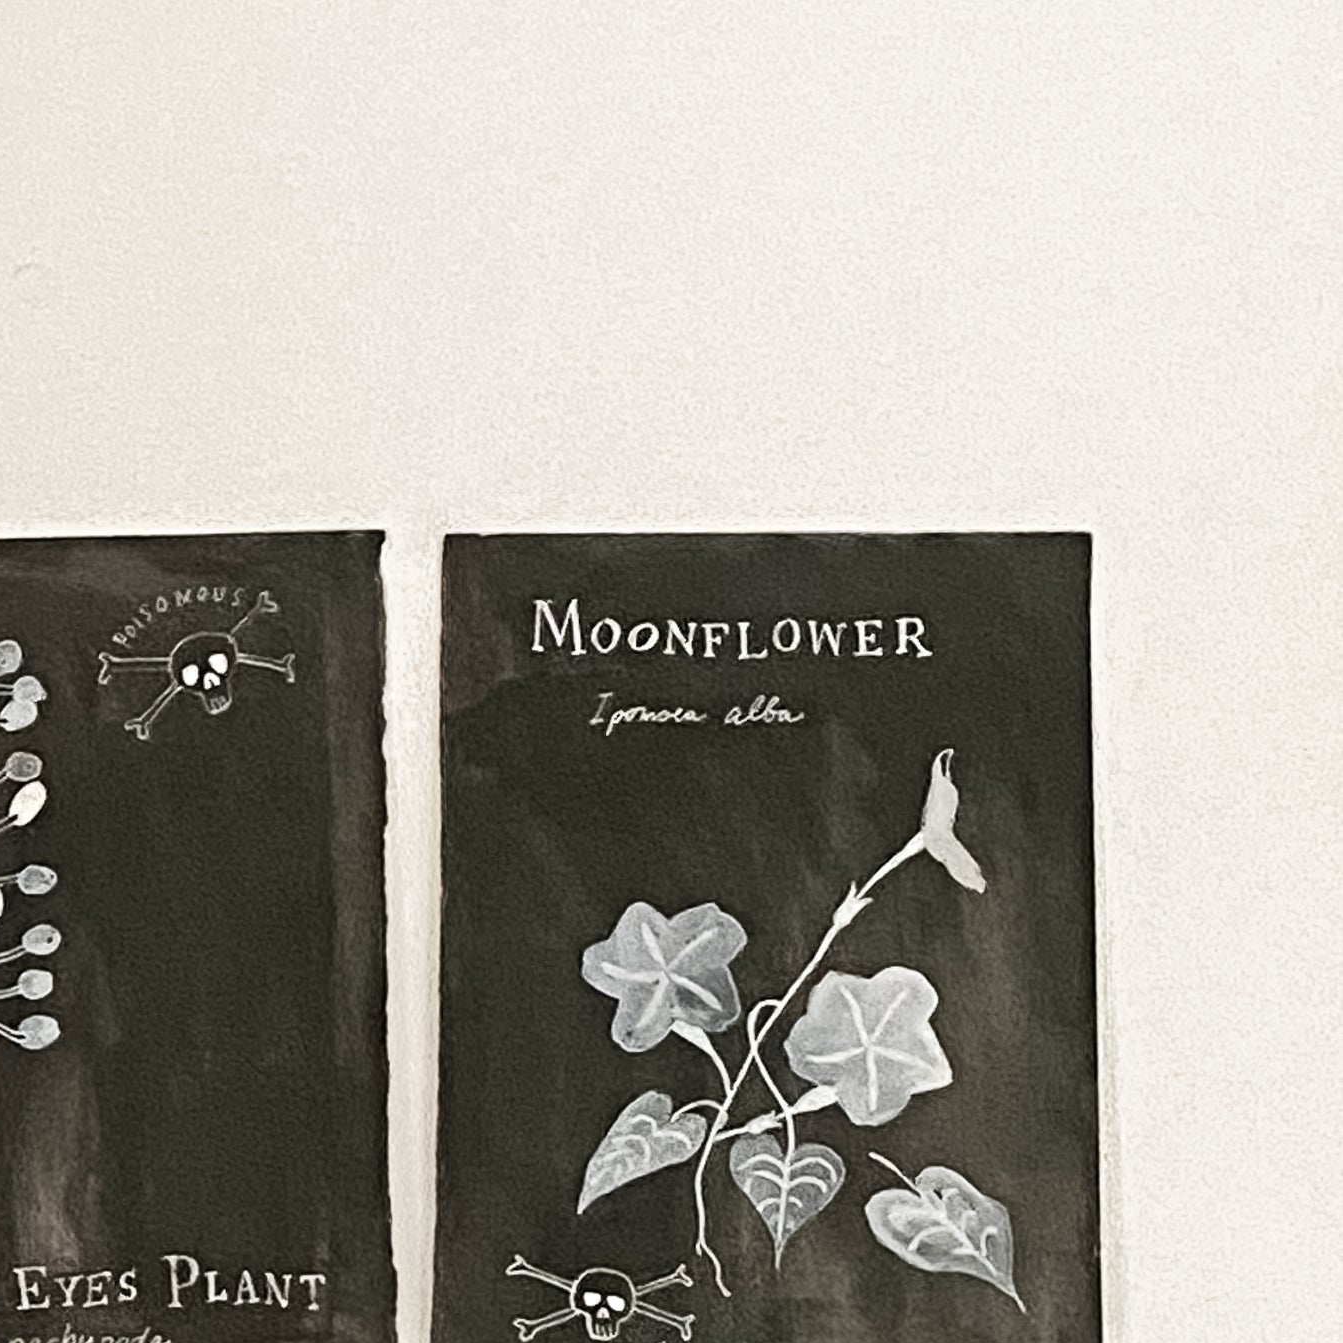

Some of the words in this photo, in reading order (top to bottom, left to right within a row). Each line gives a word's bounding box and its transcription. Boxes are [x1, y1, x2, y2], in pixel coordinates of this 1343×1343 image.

[113, 586, 244, 650] POISONOUS
[531, 598, 932, 659] MOONFLOWER
[723, 694, 805, 725] alba
[13, 1266, 138, 1311] EYES
[161, 1253, 327, 1311] PLANT
